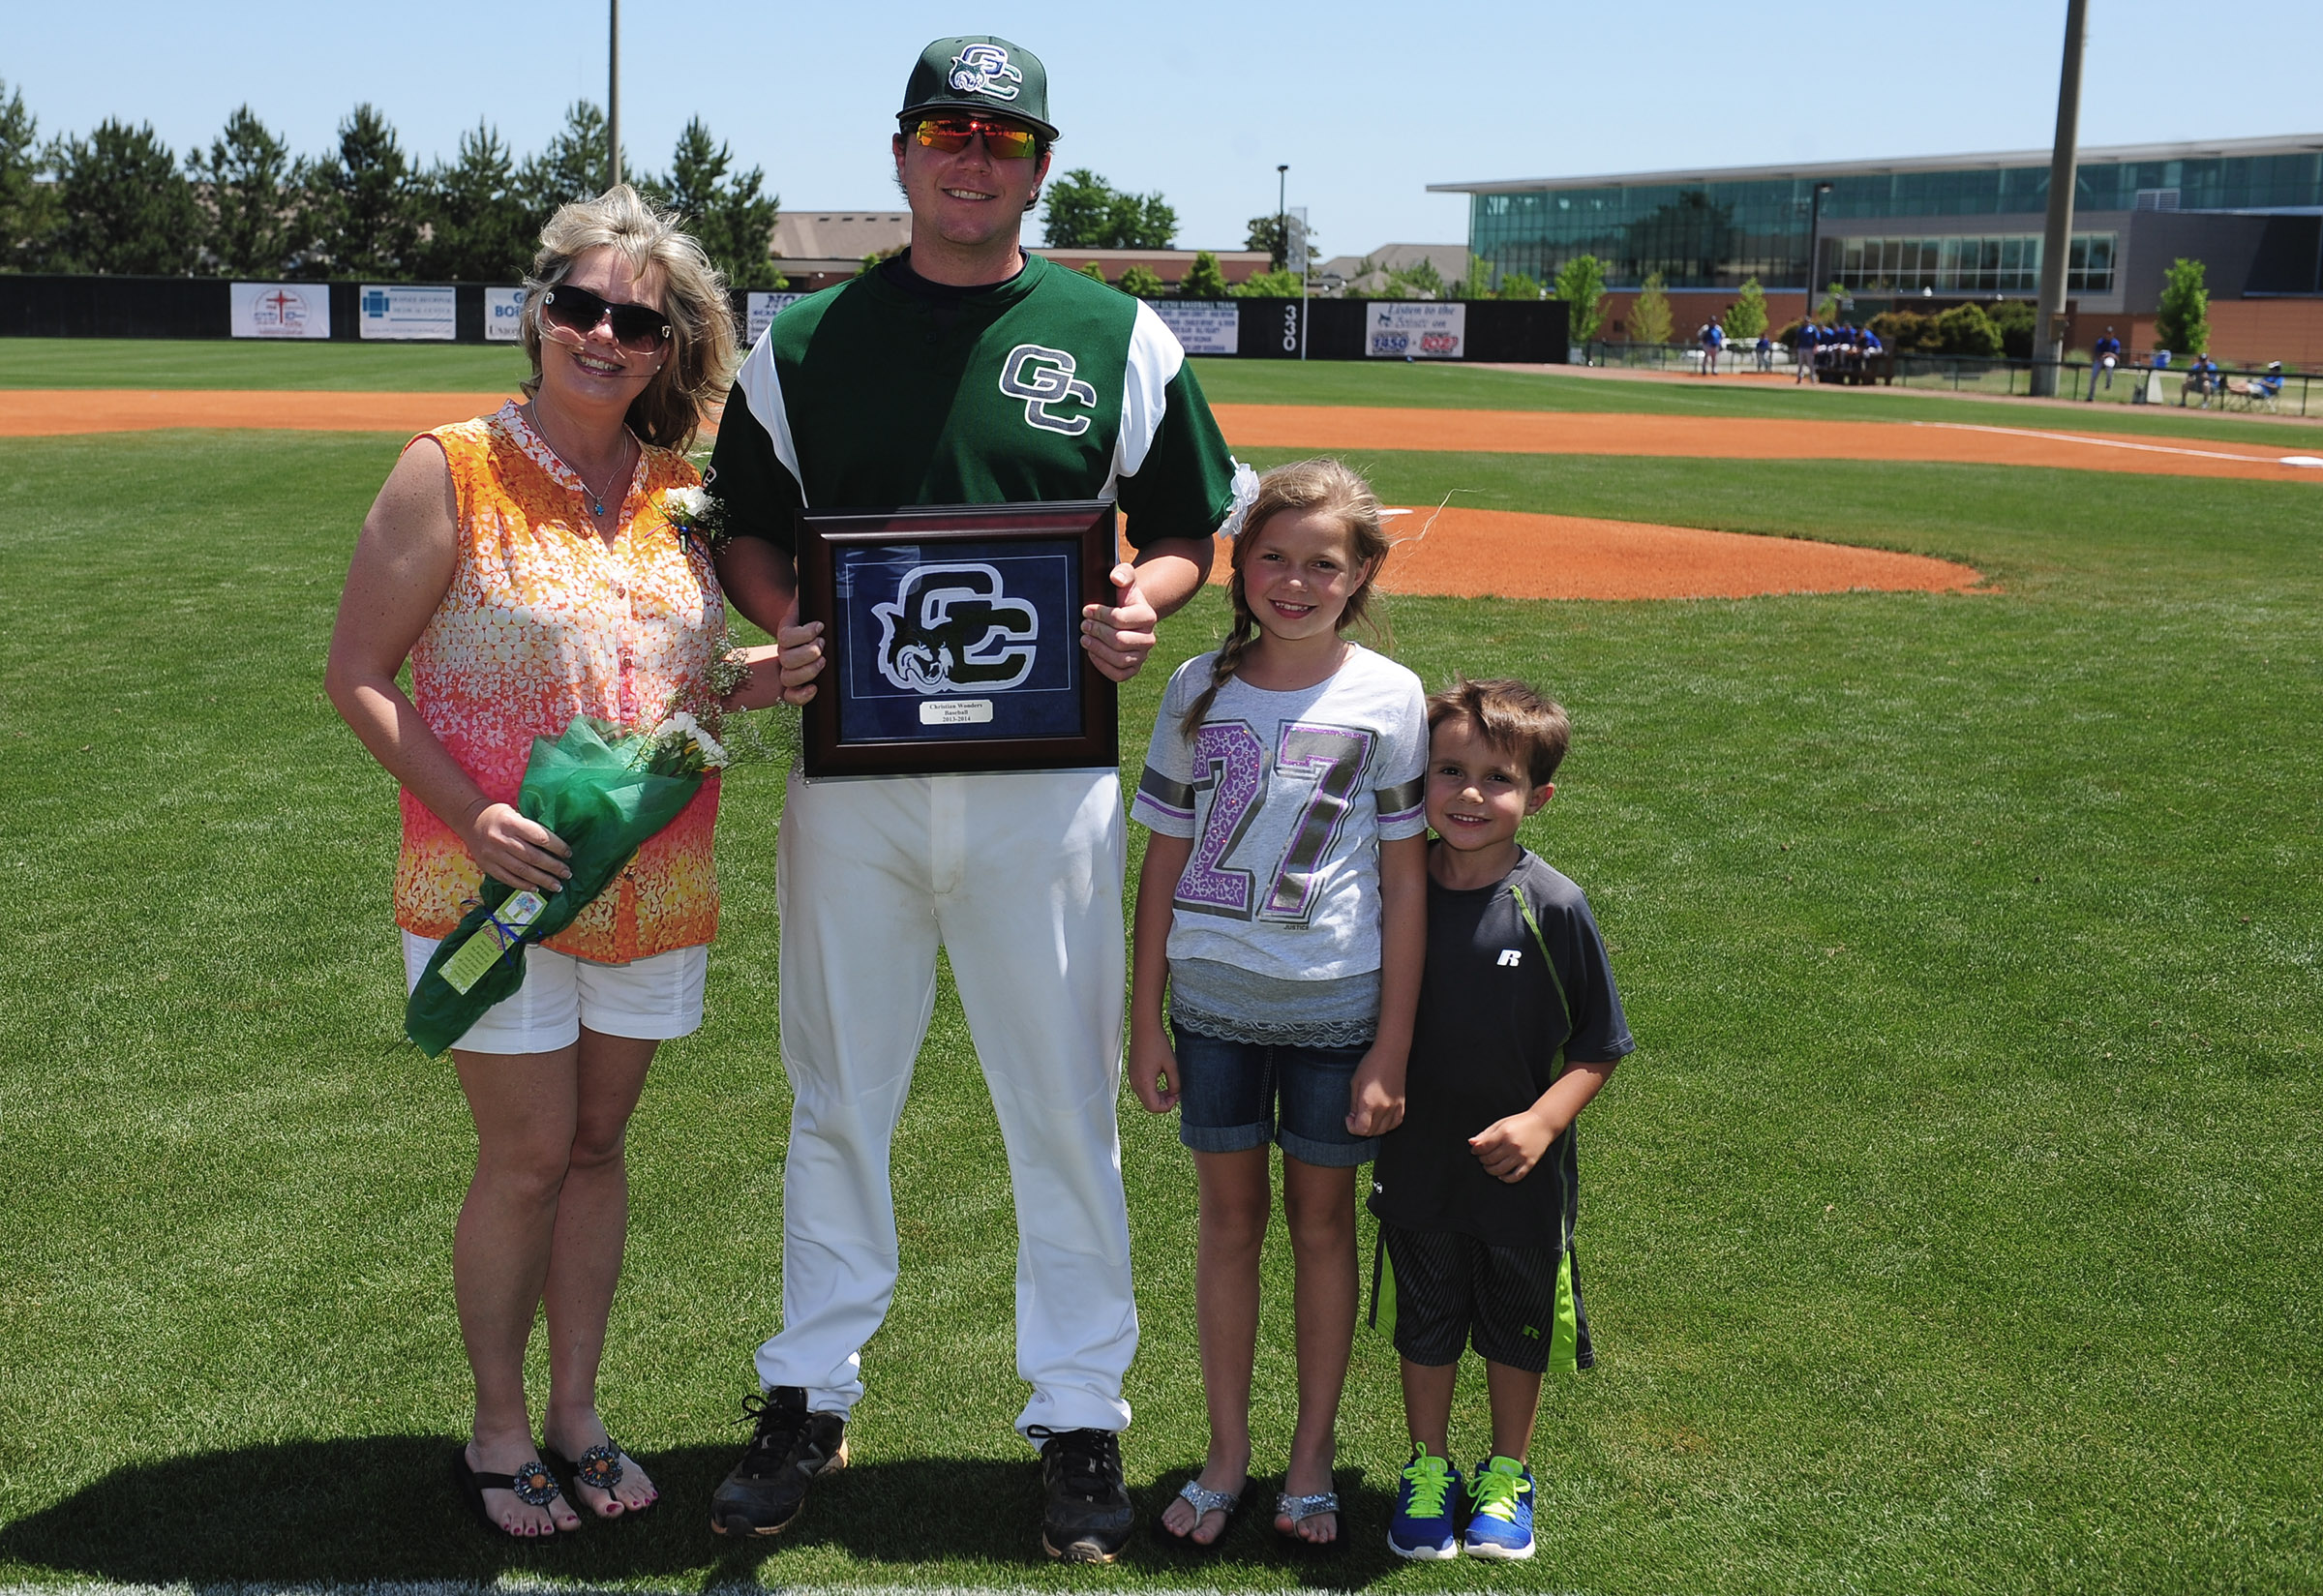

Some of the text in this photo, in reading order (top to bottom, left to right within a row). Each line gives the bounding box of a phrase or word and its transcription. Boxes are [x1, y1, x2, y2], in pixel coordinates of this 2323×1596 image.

[1282, 304, 1297, 351] 330
[999, 344, 1098, 437] GC
[1173, 718, 1378, 924] 27
[1496, 949, 1522, 966] R
